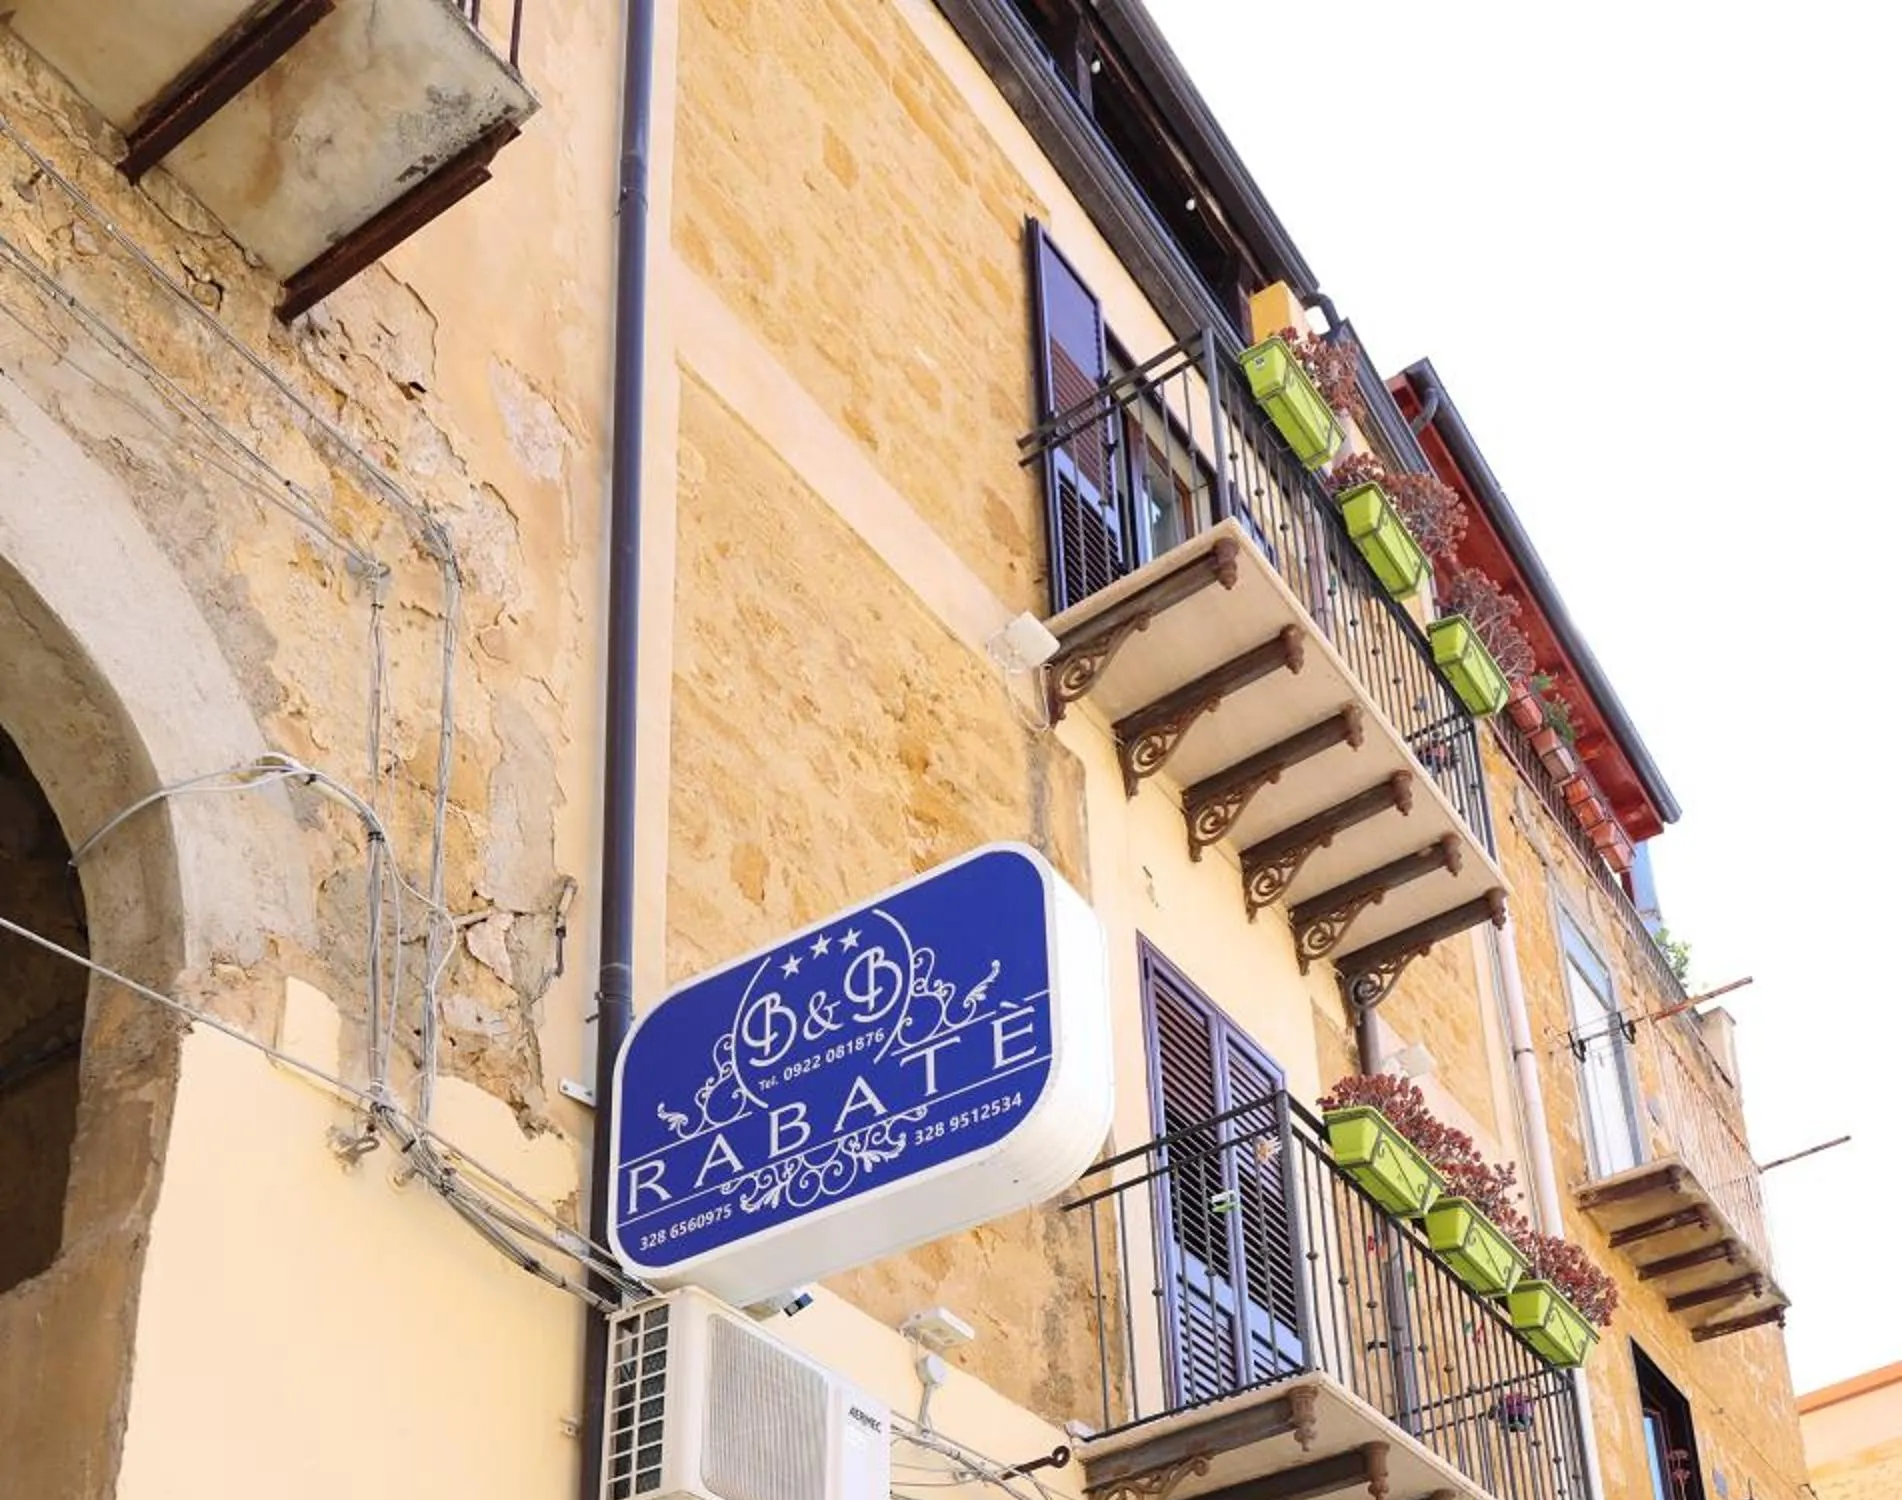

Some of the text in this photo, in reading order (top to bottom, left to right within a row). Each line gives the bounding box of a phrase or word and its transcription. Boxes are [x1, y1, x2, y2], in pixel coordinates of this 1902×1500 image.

[783, 1054, 821, 1081] 0922
[825, 1027, 885, 1063] 081876
[626, 1000, 1037, 1215] RABATÈ
[914, 1091, 1022, 1146] 328 9512534
[639, 1203, 732, 1251] 328 6560975
